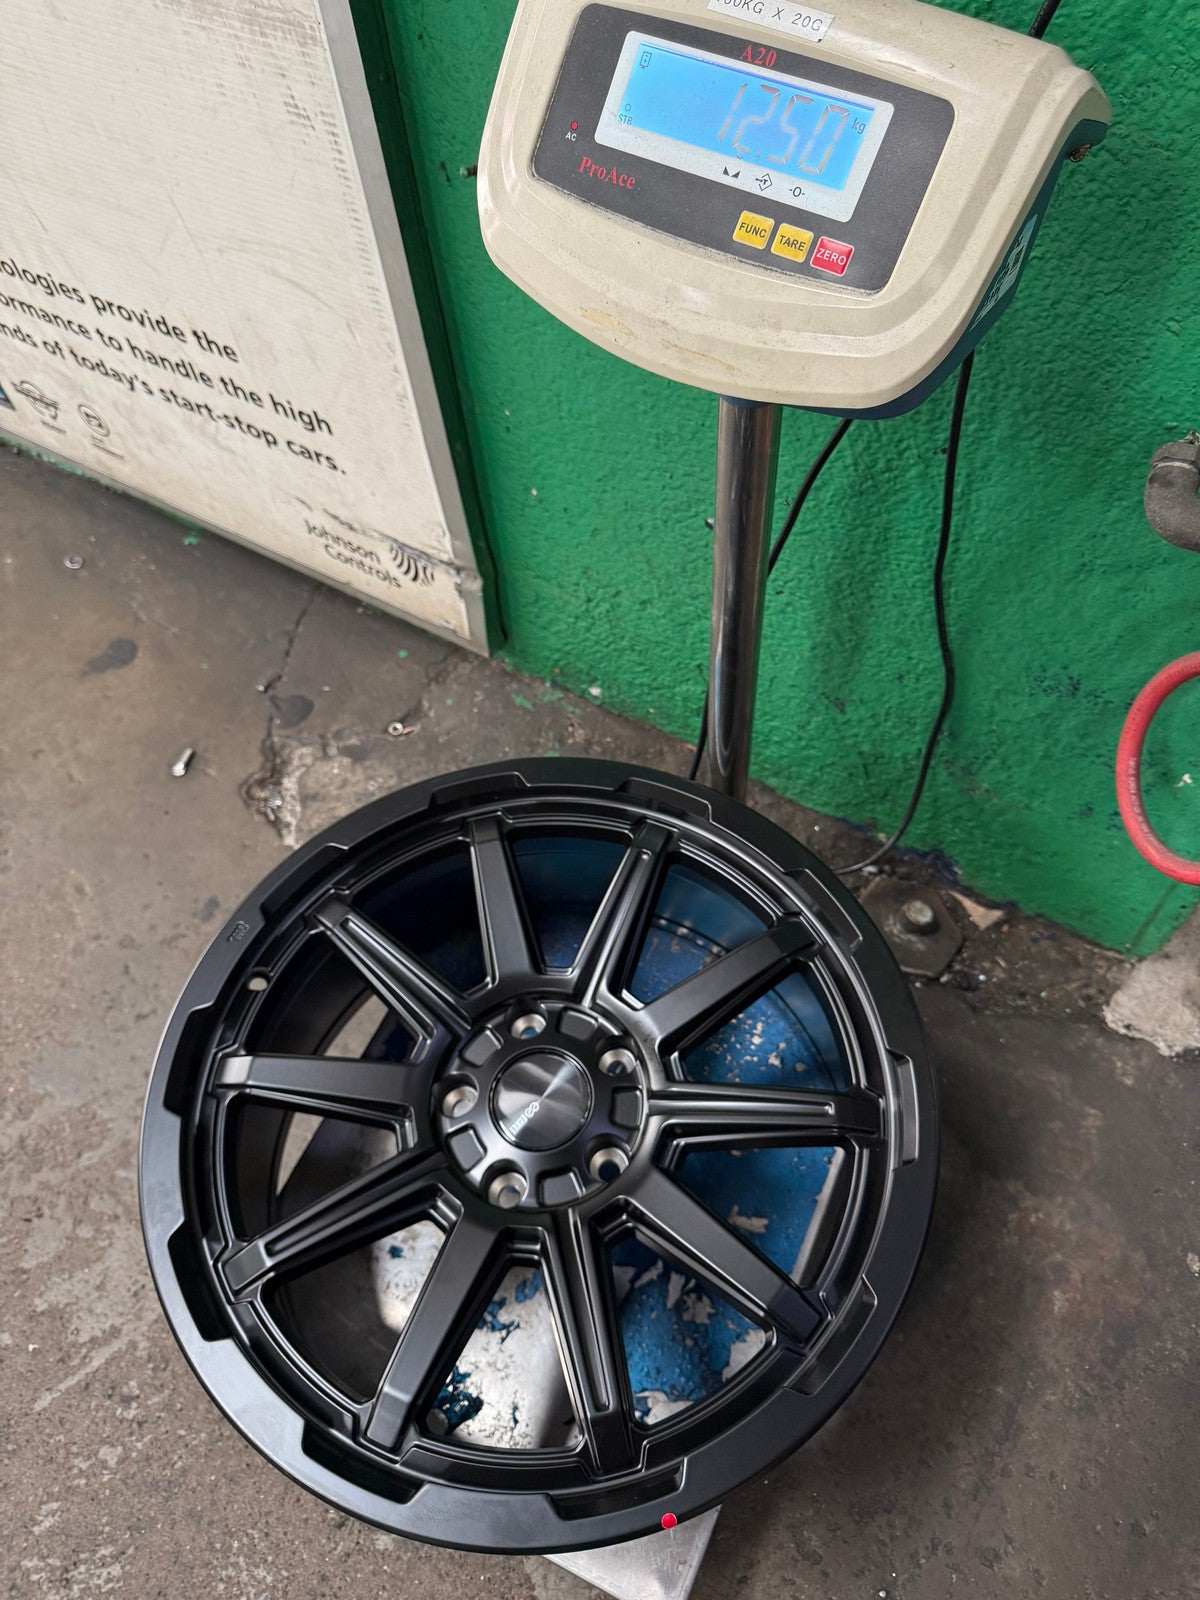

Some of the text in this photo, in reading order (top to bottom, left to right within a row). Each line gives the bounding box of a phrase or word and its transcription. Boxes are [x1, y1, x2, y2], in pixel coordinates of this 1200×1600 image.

[716, 0, 823, 32] 0KG X 20G
[740, 44, 777, 68] A20
[617, 113, 634, 126] STB
[851, 117, 866, 135] kg
[565, 131, 577, 142] AC
[578, 155, 636, 190] ProAce
[738, 221, 767, 239] FUNC
[779, 234, 806, 252] TARE
[816, 247, 847, 266] ZERO
[0, 257, 239, 363] ologies provide the
[0, 292, 333, 436] ormance to handle the high
[42, 340, 65, 361] of
[67, 346, 154, 396] today's
[159, 386, 278, 448] start-stop
[286, 440, 347, 475] cars.
[303, 518, 381, 564] Johnson
[324, 544, 402, 589] Controls
